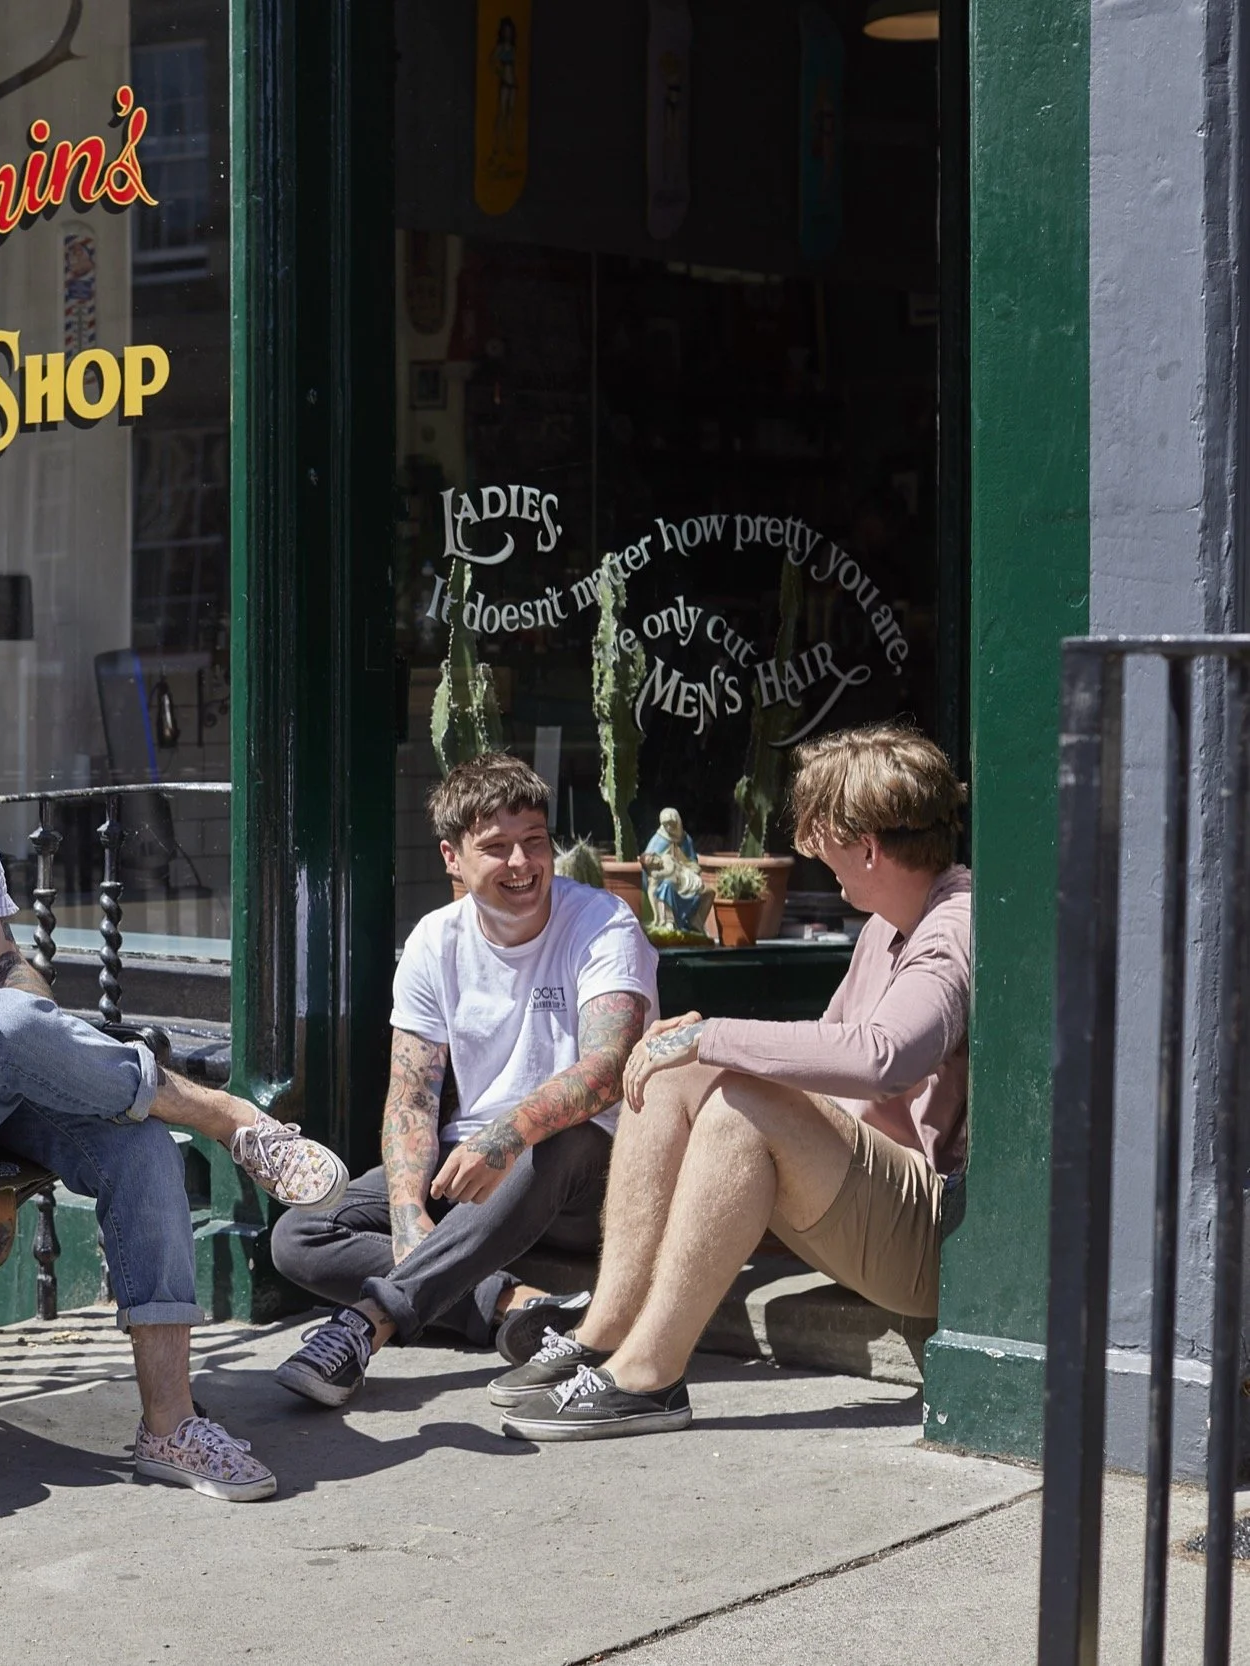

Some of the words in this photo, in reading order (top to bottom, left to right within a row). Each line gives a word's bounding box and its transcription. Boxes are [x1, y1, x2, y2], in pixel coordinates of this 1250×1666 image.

[439, 484, 563, 565] LADIES,
[426, 574, 458, 624] It
[570, 533, 652, 612] matter
[655, 514, 729, 557] how
[733, 513, 823, 566] pretty
[810, 540, 879, 611] you
[871, 601, 910, 676] are,
[642, 595, 704, 646] only
[706, 613, 759, 668] cut
[634, 656, 742, 735] MEN'S
[754, 640, 871, 748] HAIR
[531, 986, 566, 1002] OCKET
